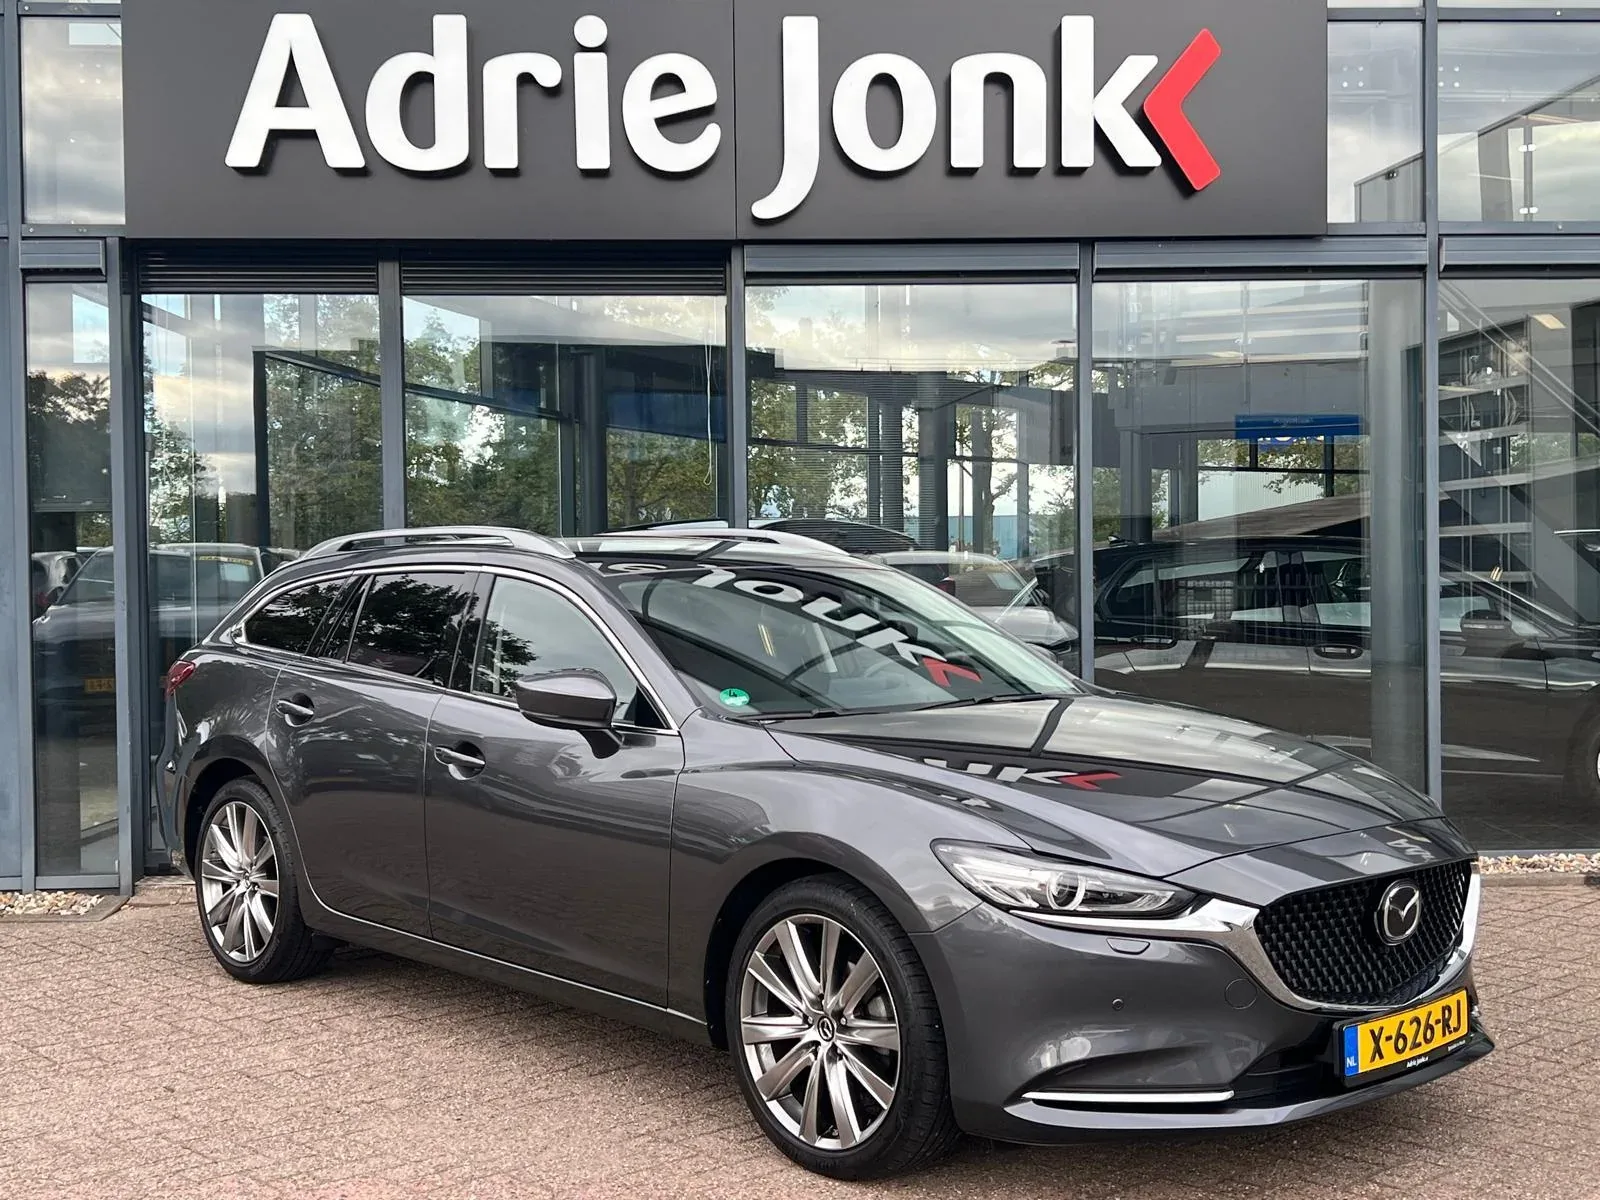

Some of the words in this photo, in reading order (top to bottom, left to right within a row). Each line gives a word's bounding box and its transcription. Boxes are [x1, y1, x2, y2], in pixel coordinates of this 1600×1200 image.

[225, 13, 722, 173] Adrie
[751, 15, 1162, 220] Jonk
[1346, 1056, 1358, 1068] NL
[1369, 999, 1461, 1064] X-626-RJ
